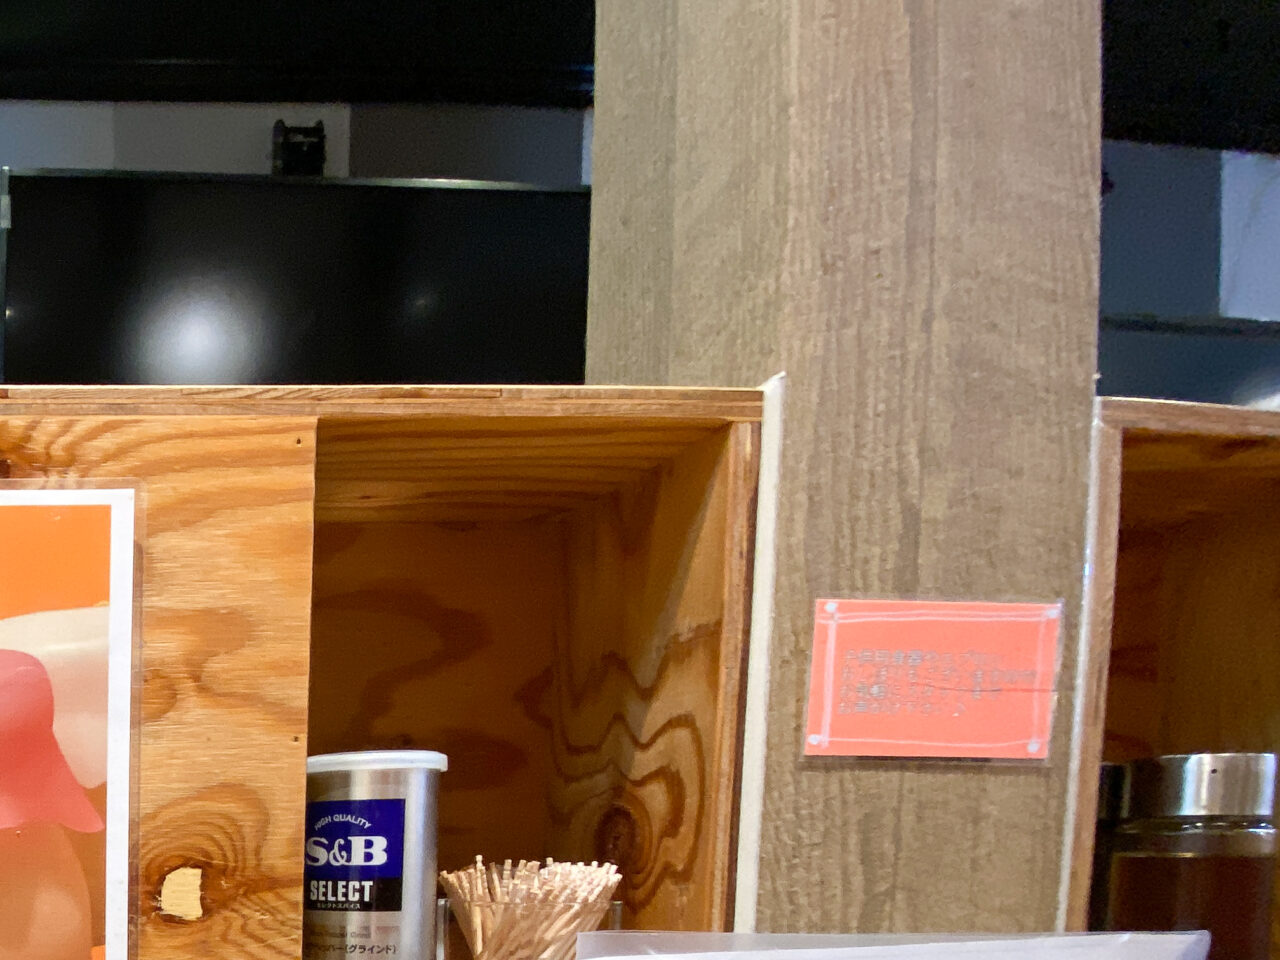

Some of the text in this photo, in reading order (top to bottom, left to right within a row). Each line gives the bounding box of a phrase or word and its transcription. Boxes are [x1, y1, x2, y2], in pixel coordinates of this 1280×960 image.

[333, 813, 372, 830] QUALITY
[306, 836, 388, 866] S&B
[310, 880, 374, 901] SELECT
